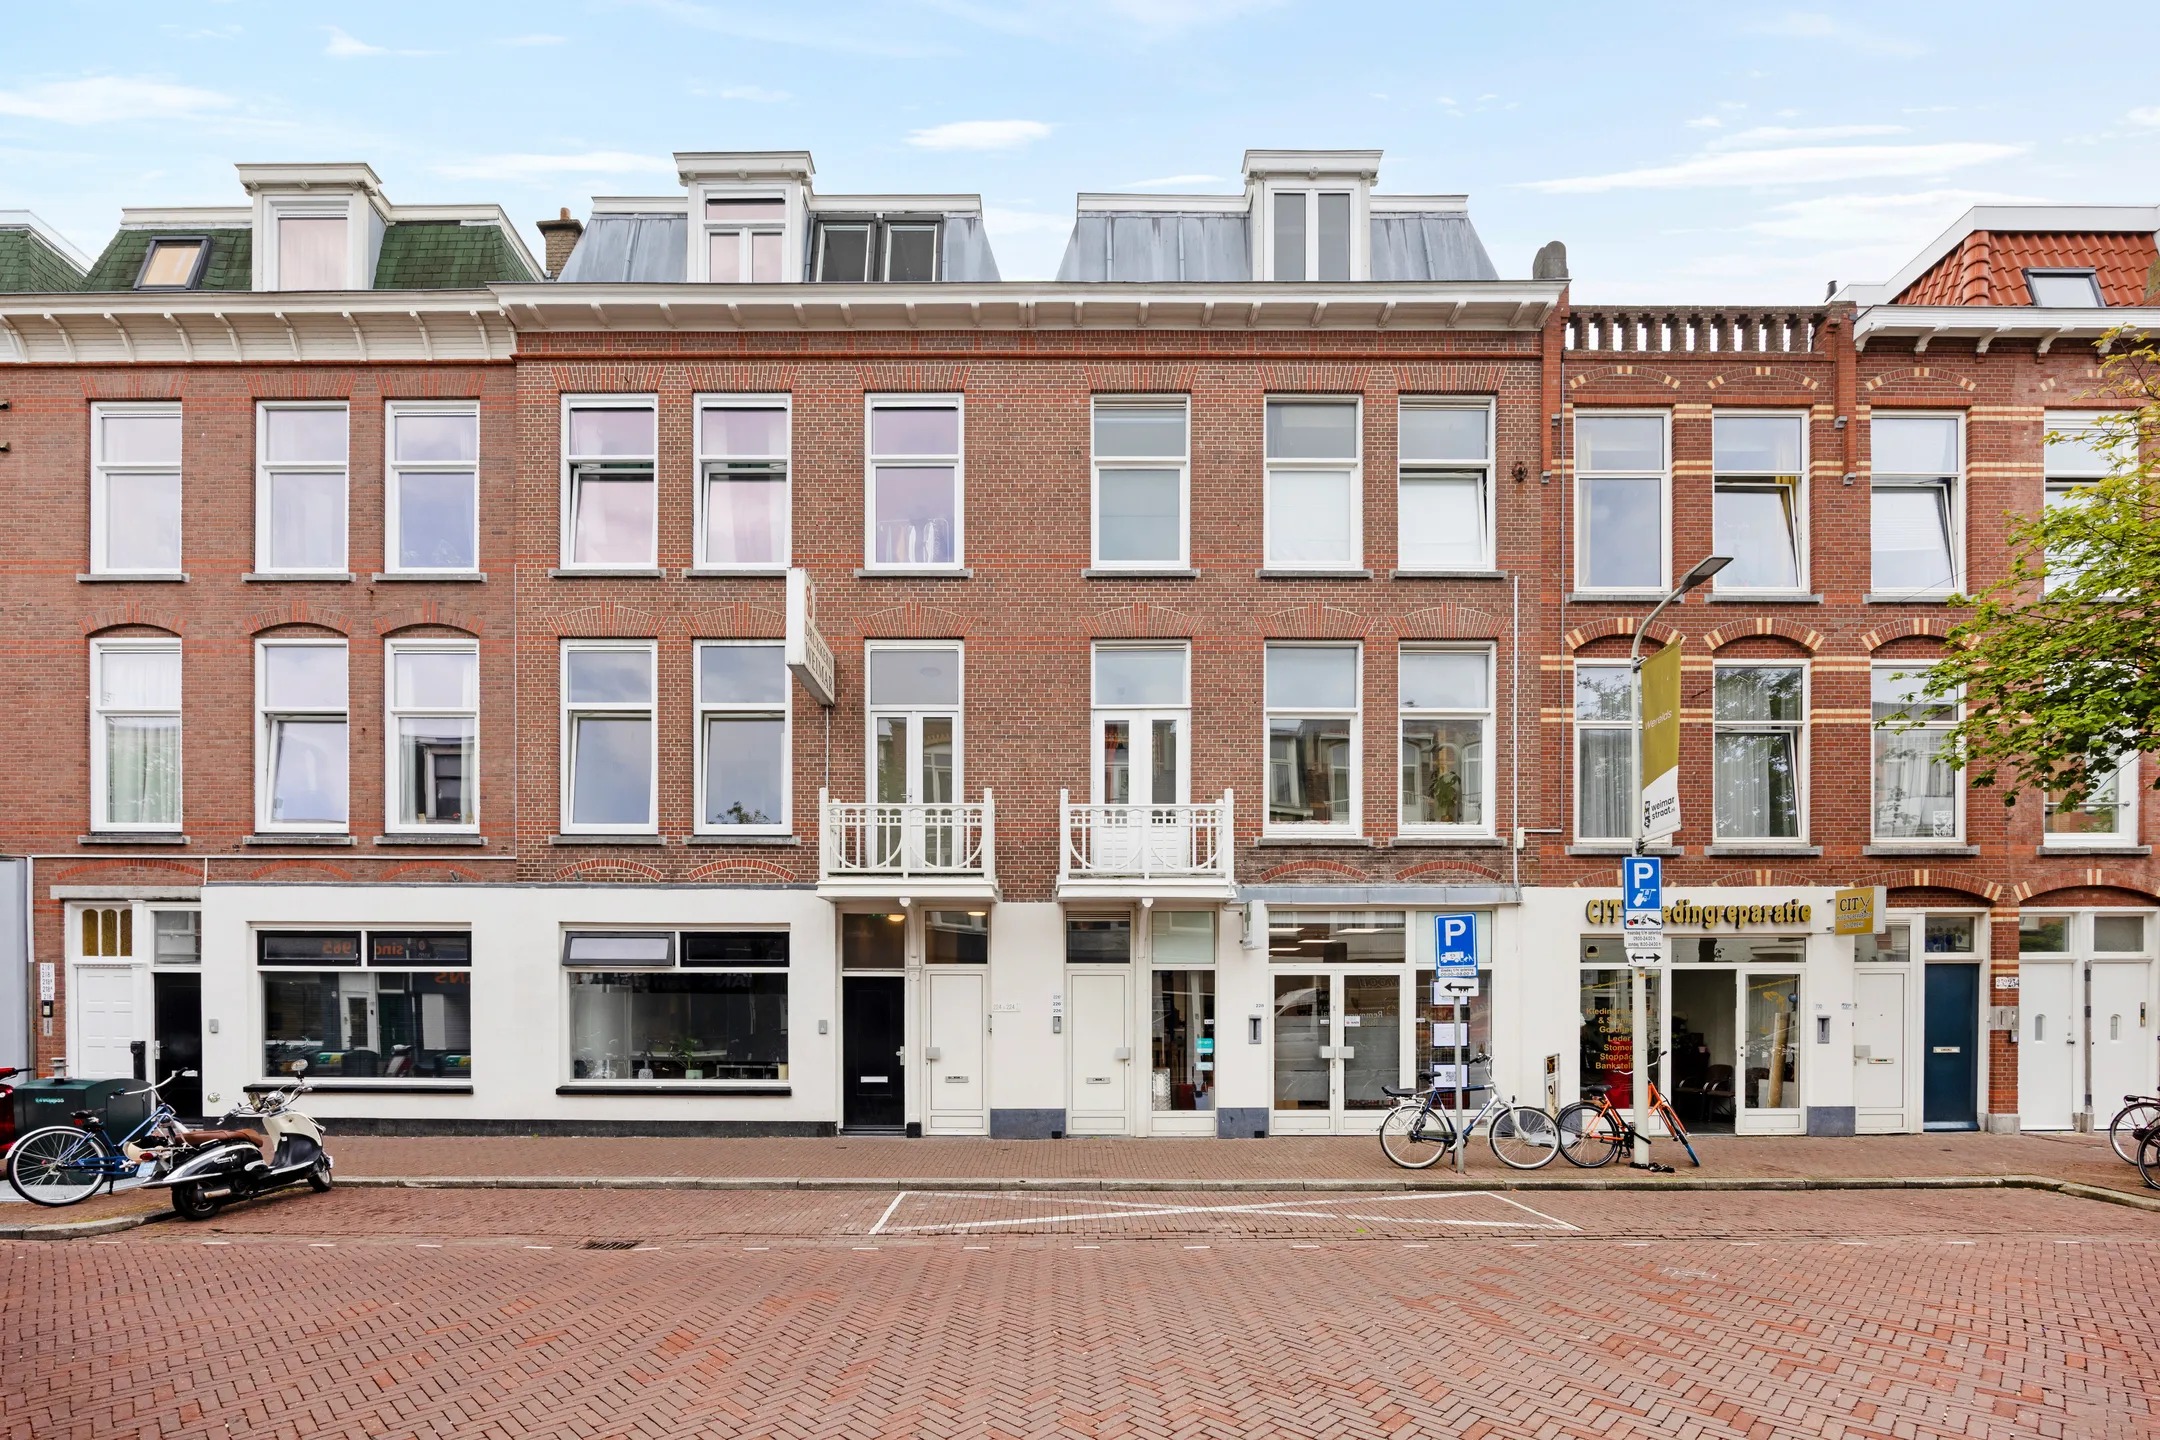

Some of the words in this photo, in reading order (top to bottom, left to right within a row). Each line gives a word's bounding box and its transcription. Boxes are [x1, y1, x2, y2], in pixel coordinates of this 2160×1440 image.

[804, 620, 833, 675] DRUKKERIJ
[804, 641, 834, 696] WEIMAR
[1651, 796, 1675, 811] weimar
[1634, 862, 1654, 889] P
[1586, 899, 1624, 924] CIT
[1661, 898, 1813, 929] edingreparatie
[1445, 919, 1467, 947] P
[1586, 1008, 1633, 1016] Kledingrep
[1599, 1053, 1633, 1061] Stoppag
[1603, 1043, 1633, 1051] Stomer
[1595, 1062, 1633, 1070] Bankstell
